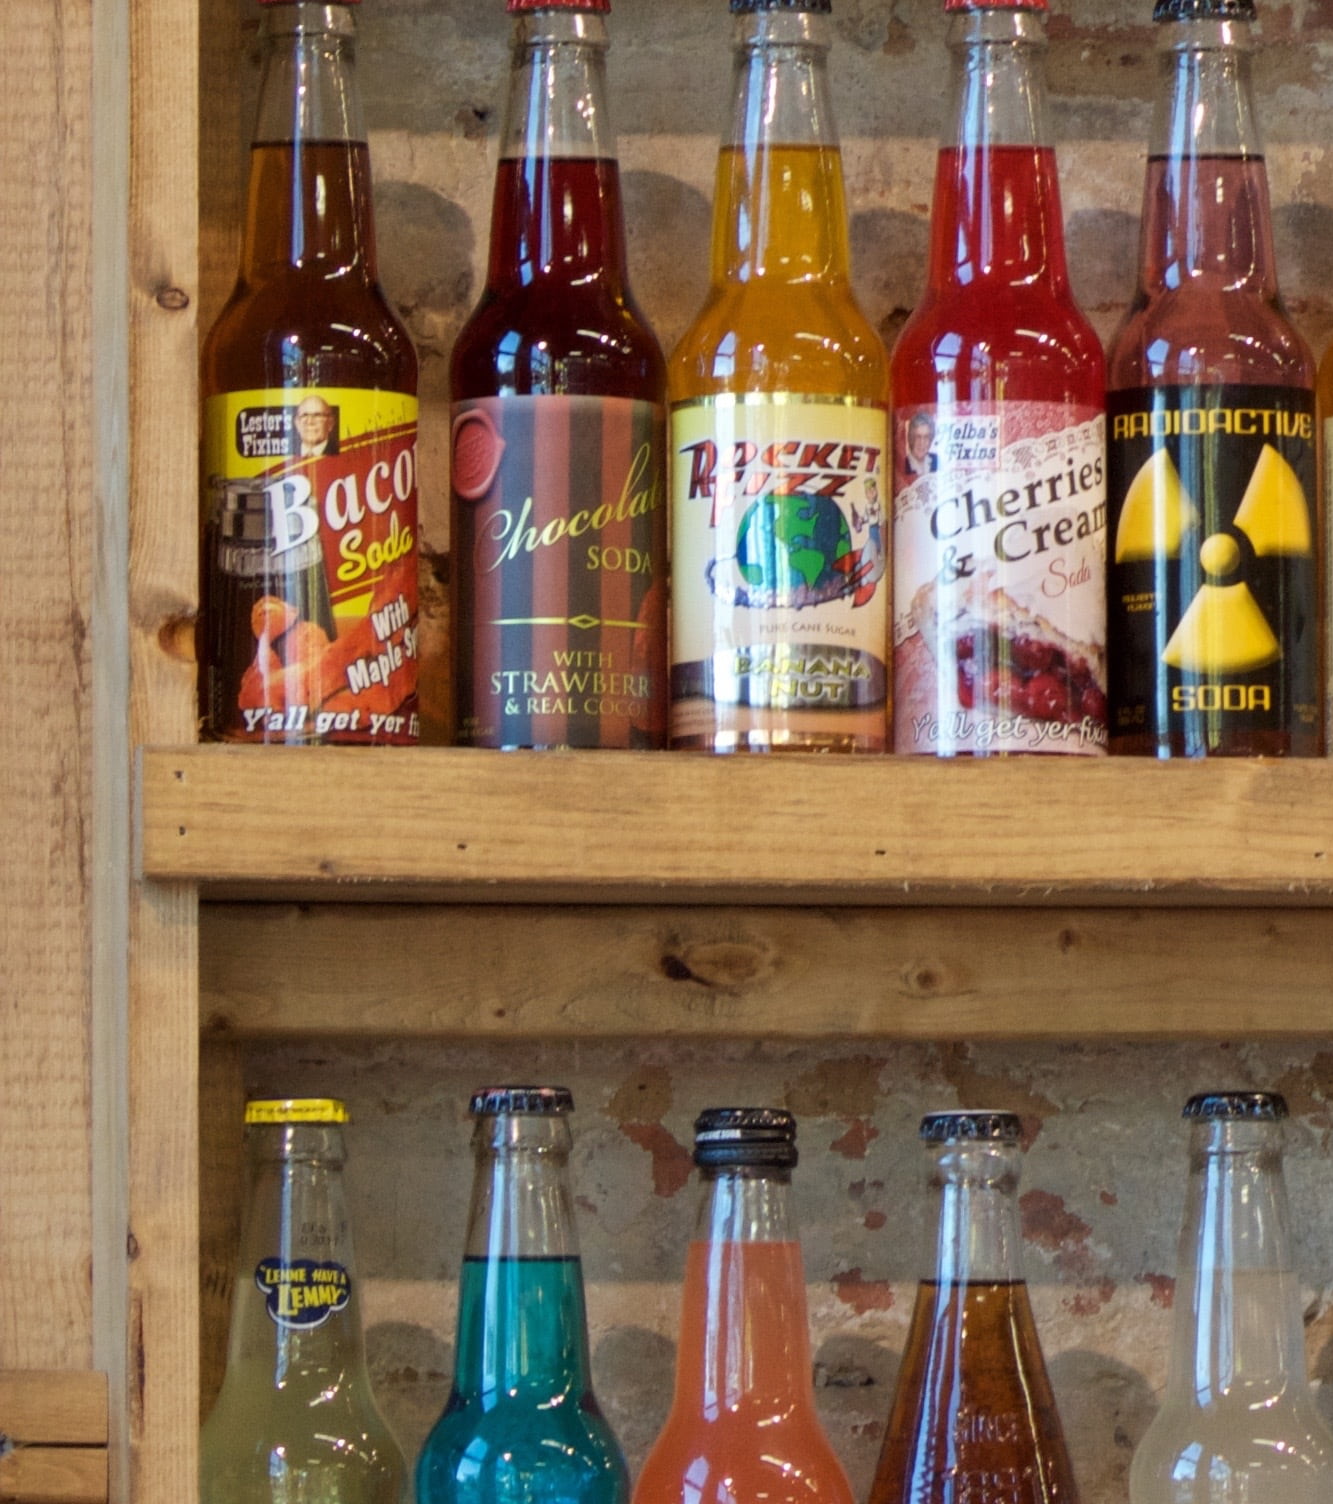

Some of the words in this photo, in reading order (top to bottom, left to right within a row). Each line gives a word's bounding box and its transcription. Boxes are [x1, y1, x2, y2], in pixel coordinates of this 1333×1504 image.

[240, 410, 292, 437] Lester's
[1114, 412, 1311, 439] RADIOACTIVE
[929, 464, 1104, 541] Cherries
[338, 525, 413, 582] Soda
[1172, 685, 1270, 710] SODA
